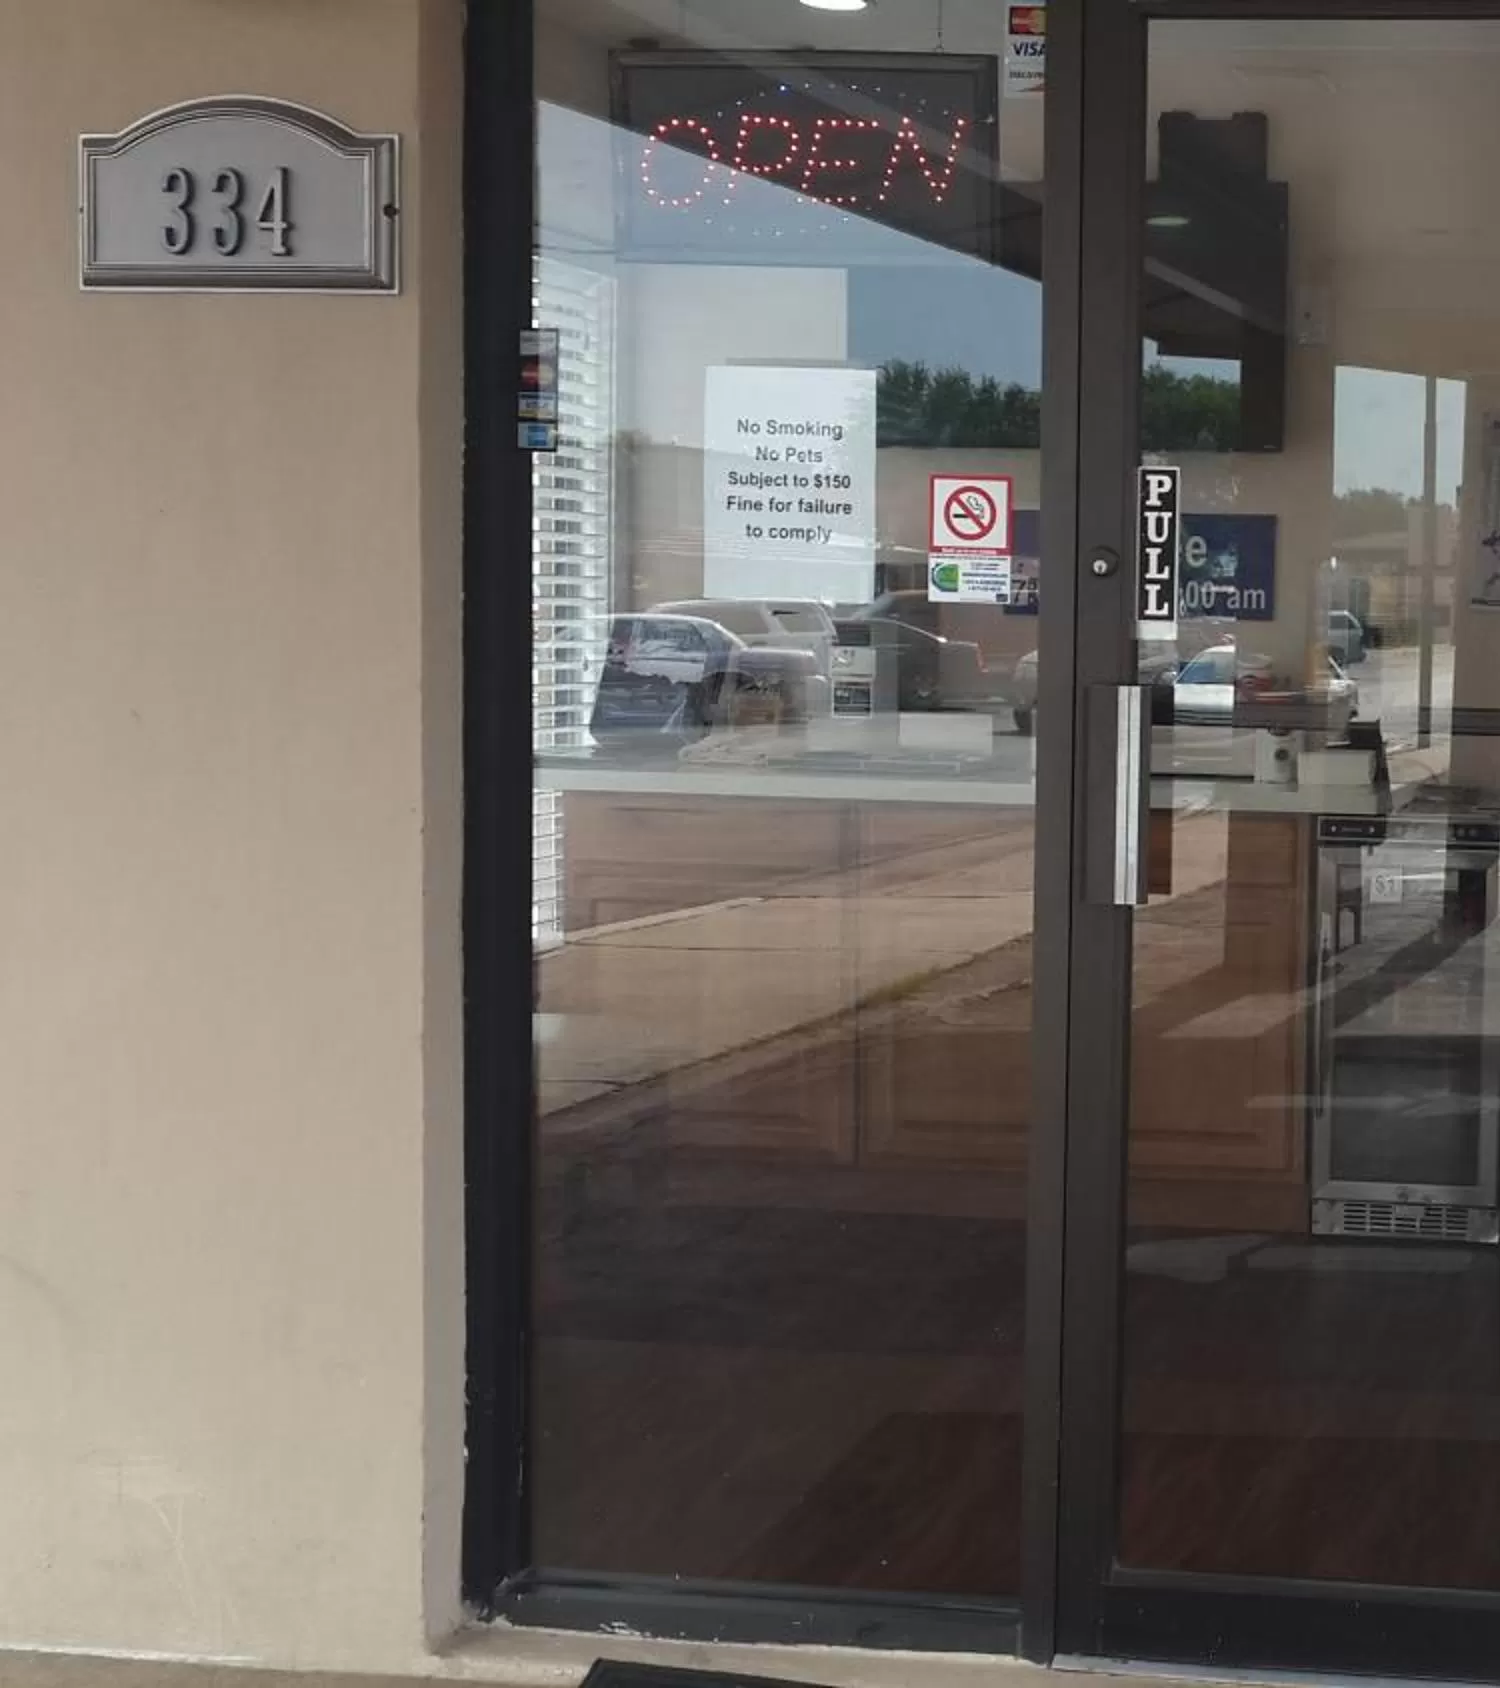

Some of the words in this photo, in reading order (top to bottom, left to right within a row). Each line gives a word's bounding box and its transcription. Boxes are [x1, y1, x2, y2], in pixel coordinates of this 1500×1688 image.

[640, 115, 967, 205] OPEN
[160, 167, 294, 257] 334
[736, 419, 761, 435] No
[766, 419, 844, 441] Smoking
[755, 446, 780, 462] No
[785, 447, 824, 463] Pets
[727, 471, 789, 490] Subject
[793, 474, 809, 488] to
[813, 473, 852, 490] $150
[726, 495, 764, 512] Fine
[768, 496, 793, 513] for
[798, 498, 853, 515] failure
[745, 524, 764, 539] to
[768, 525, 833, 544] comply
[1143, 474, 1173, 616] PULL
